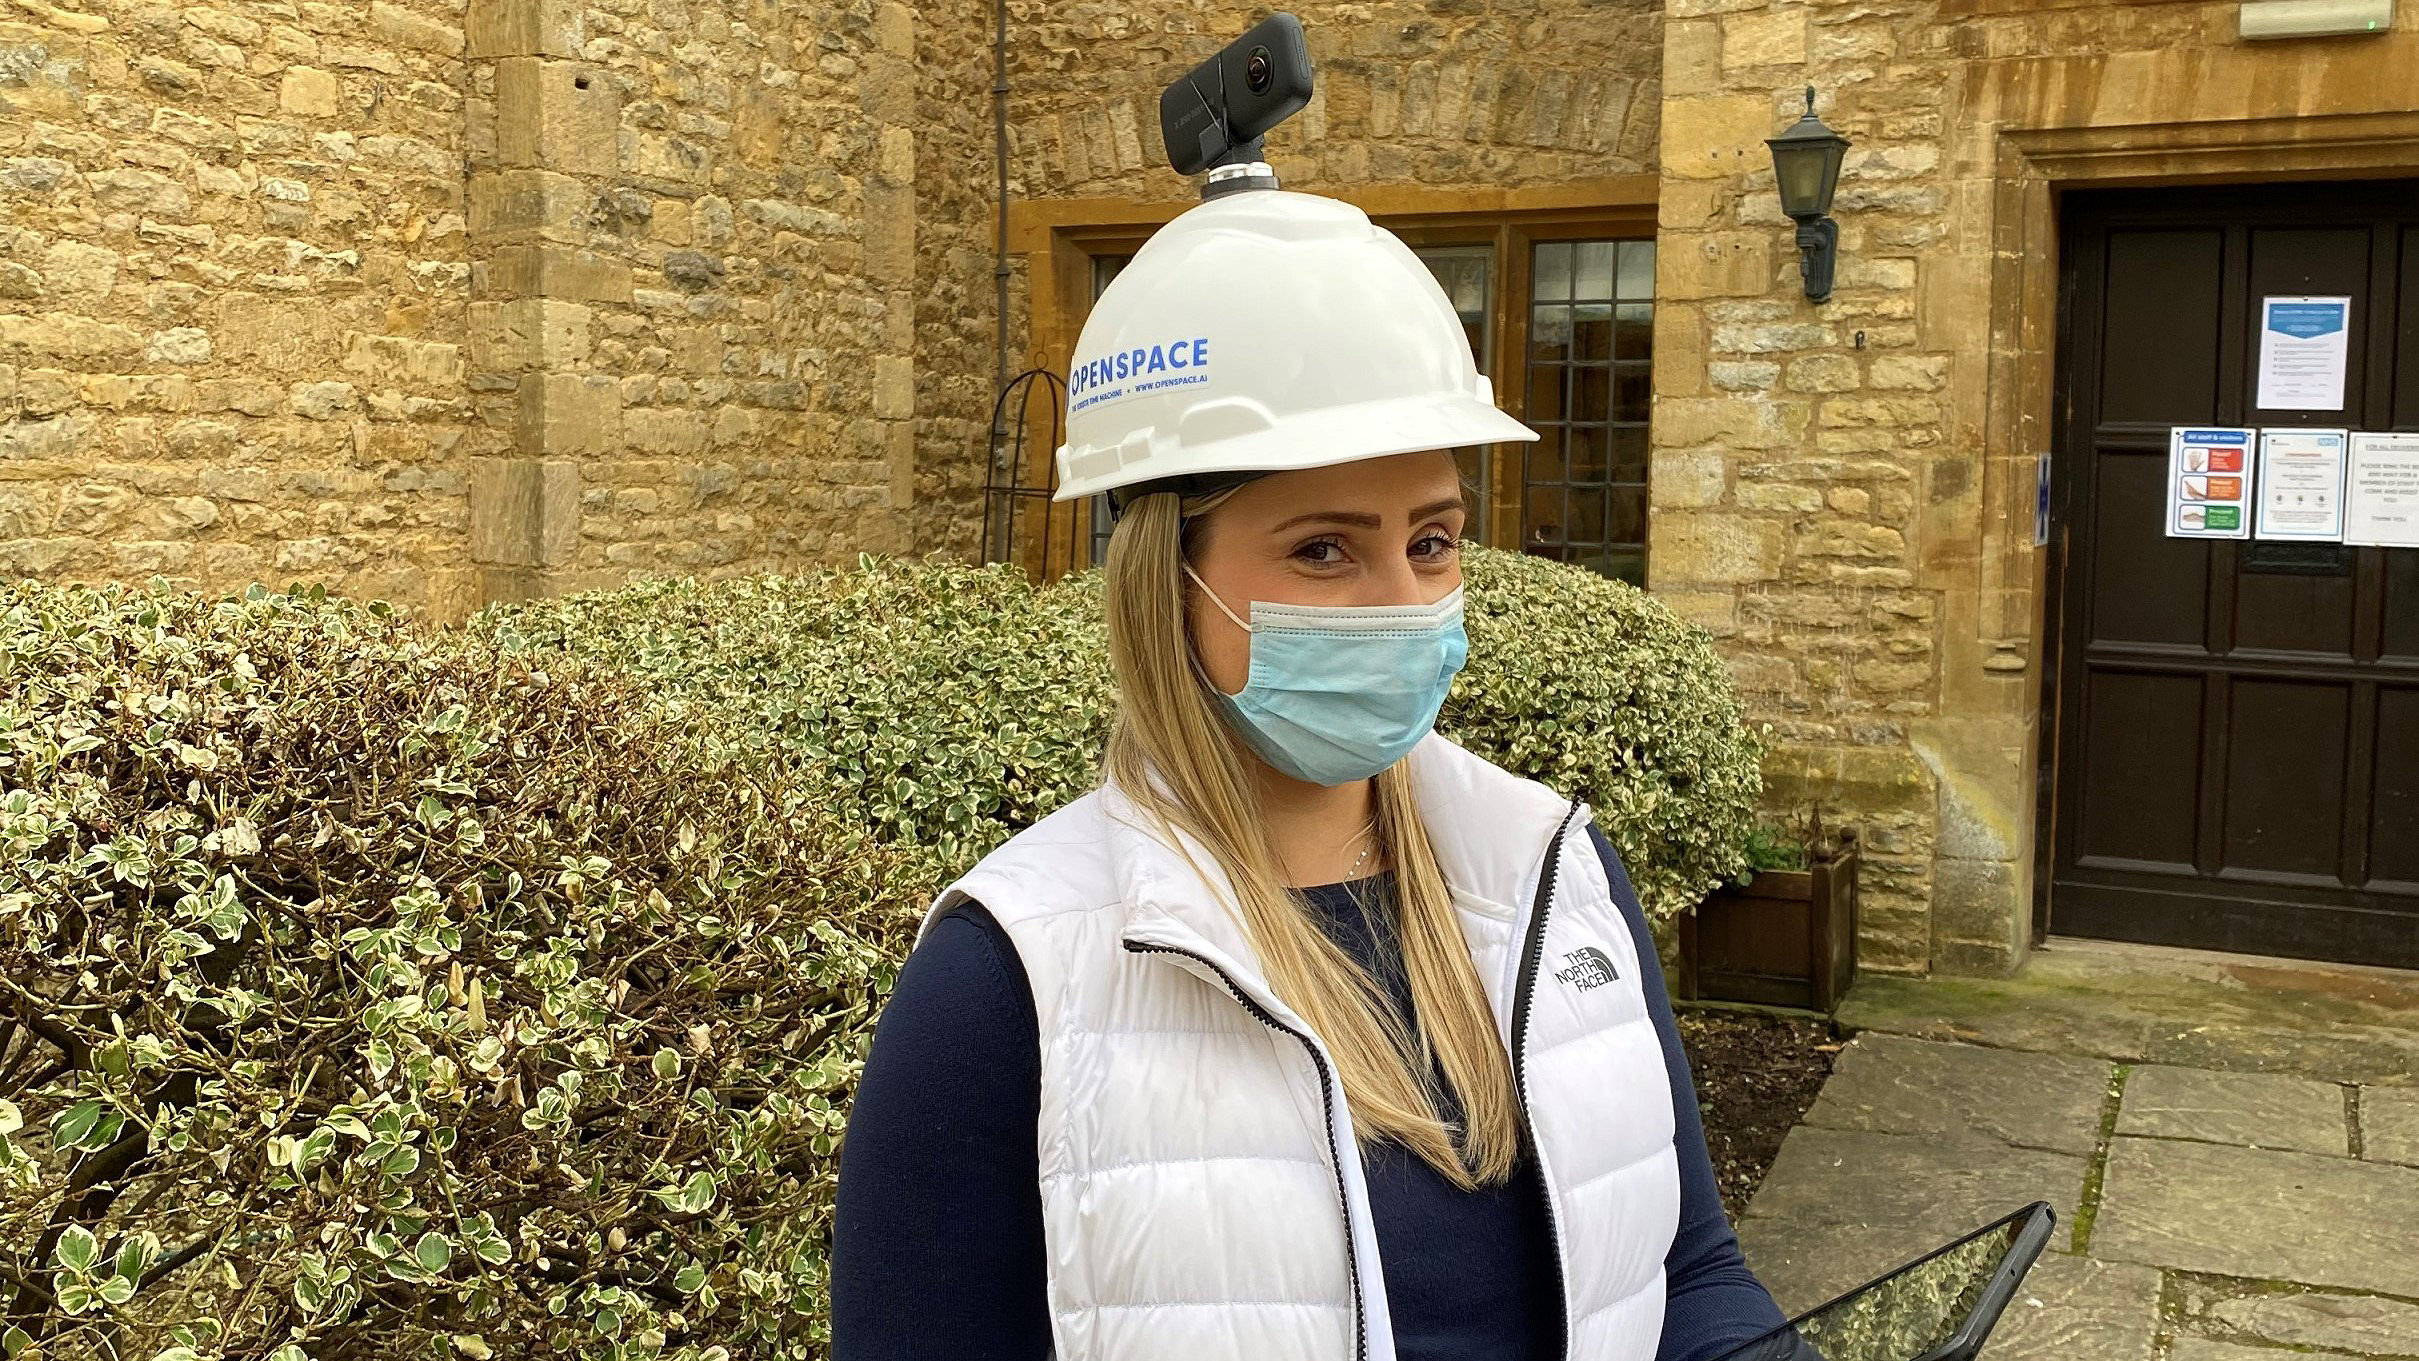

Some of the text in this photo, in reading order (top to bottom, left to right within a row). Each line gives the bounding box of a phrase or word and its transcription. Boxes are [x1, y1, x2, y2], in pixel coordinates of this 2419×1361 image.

[1071, 338, 1208, 396] OPENSPACE
[1563, 948, 1591, 966] THE
[1554, 959, 1599, 985] NORTH
[1574, 971, 1605, 993] FACE
